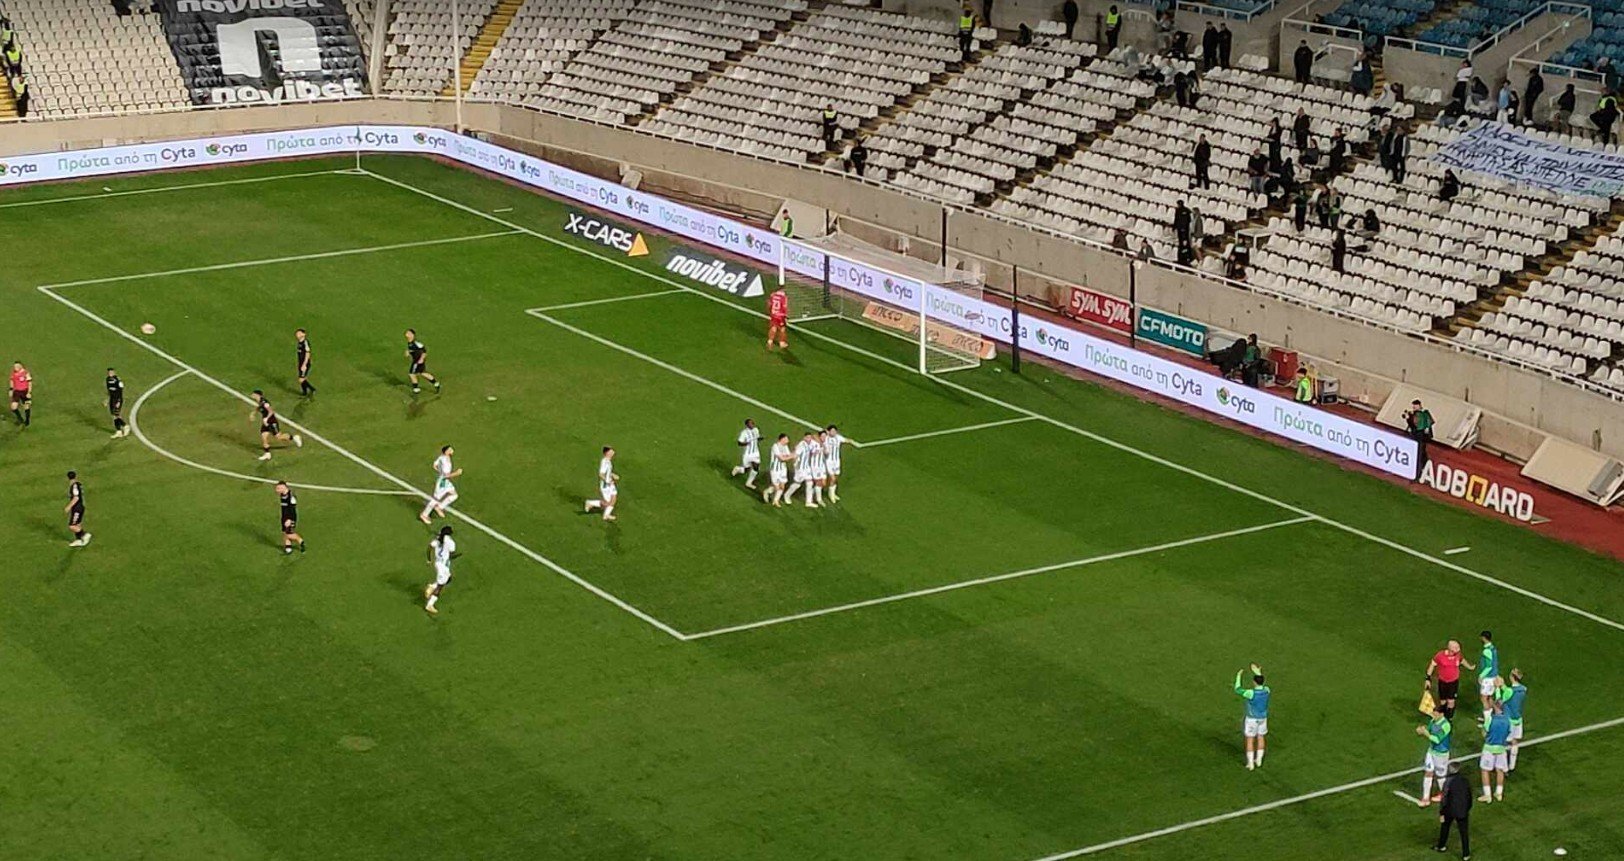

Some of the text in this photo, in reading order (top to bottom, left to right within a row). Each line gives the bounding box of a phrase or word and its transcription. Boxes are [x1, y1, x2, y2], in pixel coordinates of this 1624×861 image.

[211, 77, 363, 104] novibet
[222, 144, 247, 156] cyta
[266, 135, 315, 152] Πρώτα
[319, 133, 343, 146] από
[365, 131, 398, 146] Cyta
[428, 135, 446, 148] cyta
[58, 147, 196, 172] Πρώτα από τη Cyta
[498, 154, 516, 170] Cyta
[10, 163, 38, 177] cyta
[599, 187, 618, 204] Cyta
[564, 213, 633, 252] X-CARS
[718, 225, 739, 243] Cyta
[755, 239, 771, 254] cyta
[665, 254, 749, 294] novibet
[837, 267, 847, 282] τη
[849, 267, 873, 287] Cyta
[894, 285, 913, 300] cyta
[926, 291, 963, 317] Πρώτα
[987, 317, 999, 332] τη
[1072, 290, 1131, 325] SYM SYM
[1140, 315, 1204, 347] CFMOTO
[1048, 335, 1069, 352] cyta
[1085, 344, 1203, 396] Πρώτα από τη Cyta
[1231, 395, 1255, 414] cyta
[1273, 405, 1410, 466] Πρώτα από τη Cyta
[1419, 459, 1534, 523] ADBOARD
